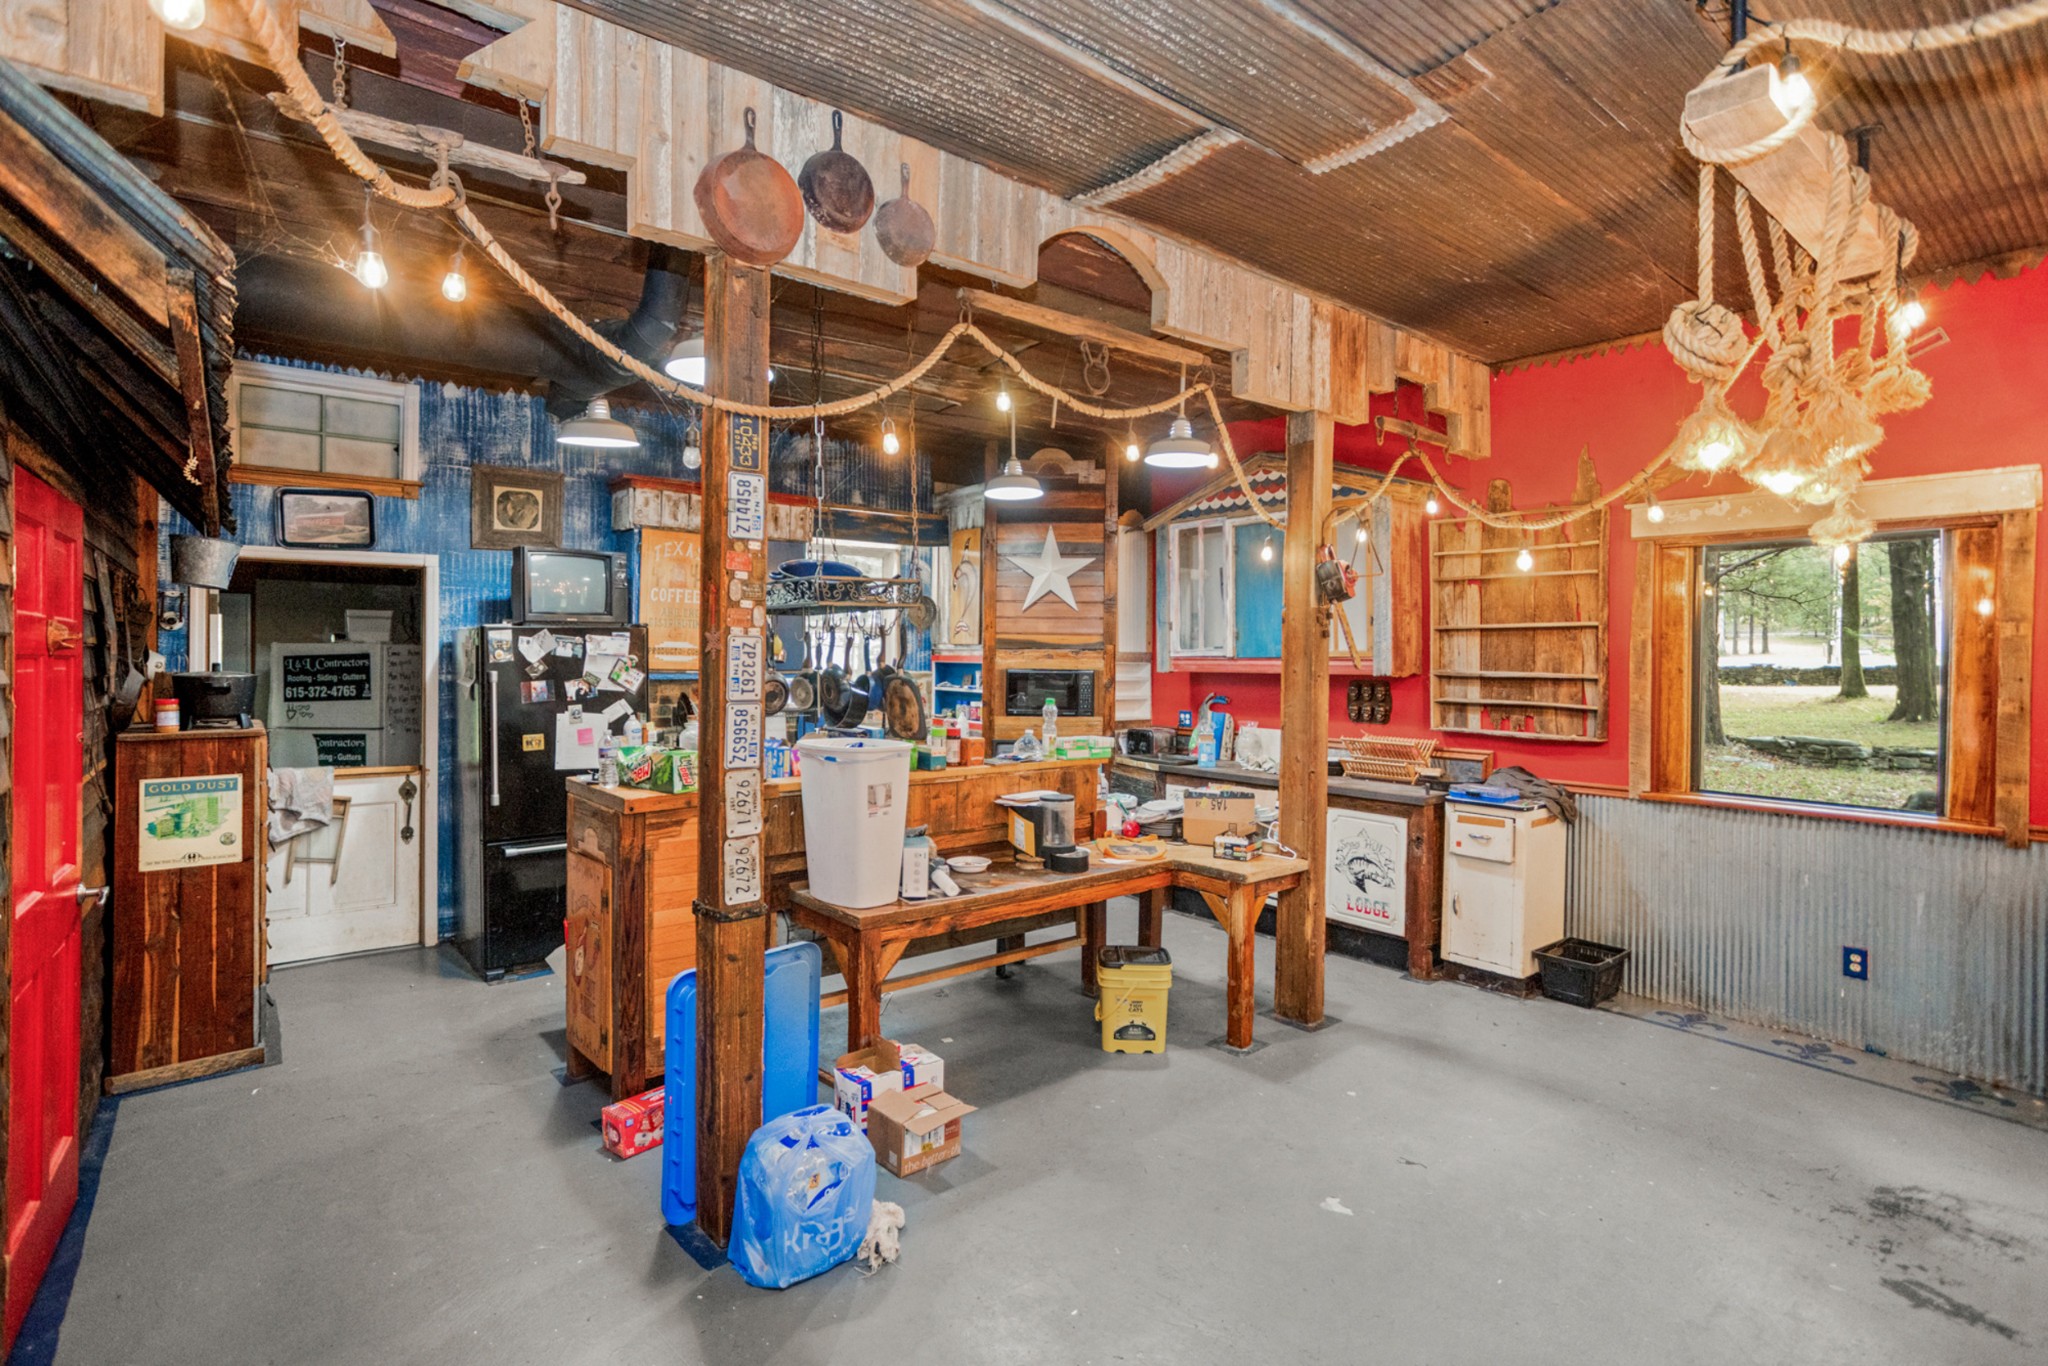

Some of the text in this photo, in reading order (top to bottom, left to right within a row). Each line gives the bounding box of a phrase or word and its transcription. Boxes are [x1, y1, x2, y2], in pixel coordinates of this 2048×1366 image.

[740, 417, 752, 466] 10433
[736, 479, 751, 533] ZT4458
[287, 674, 312, 683] Roofing
[317, 673, 338, 682] Siding
[342, 673, 366, 681] Gutters
[316, 657, 370, 670] Contractors
[741, 642, 756, 695] ZP3261
[285, 685, 356, 698] 615-372-4765
[733, 709, 748, 763] ZS9958
[337, 753, 362, 761] Gutters
[148, 780, 236, 794] GOLD DUST
[736, 779, 752, 825] 92671
[735, 847, 751, 894] 92672
[1346, 894, 1390, 919] LODGE
